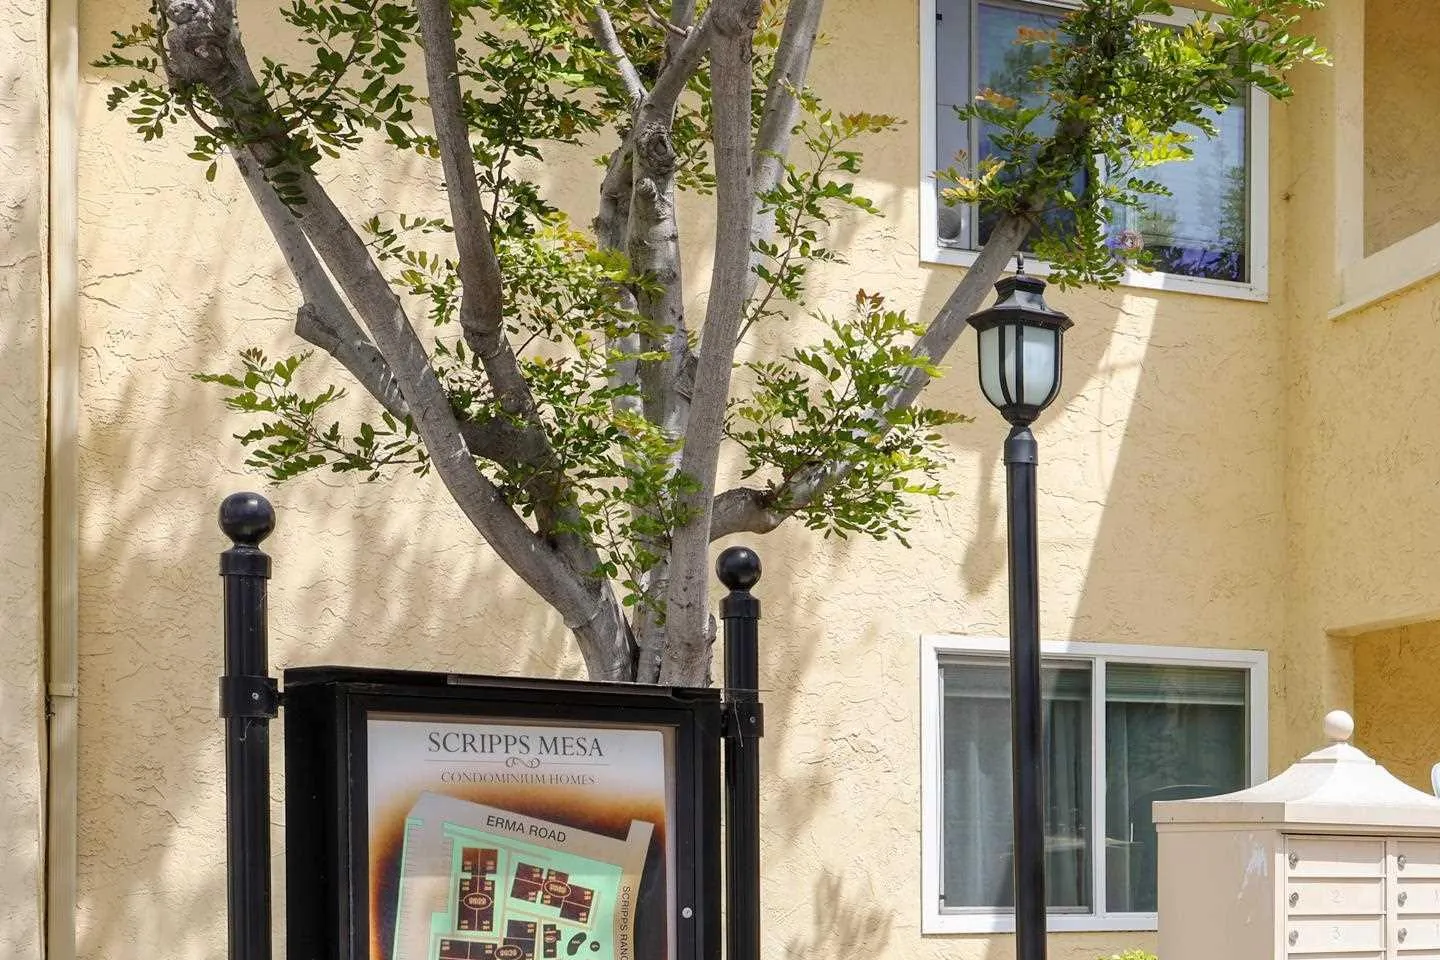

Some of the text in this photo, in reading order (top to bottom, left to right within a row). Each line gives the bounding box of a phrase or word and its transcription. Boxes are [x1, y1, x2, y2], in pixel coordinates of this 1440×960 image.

[427, 731, 604, 757] SCRIPPS MESA
[440, 770, 596, 785] CONDOMINIUM HOMES
[486, 814, 567, 844] ERMA ROAD
[620, 886, 631, 932] SCRIPPS
[1332, 926, 1342, 940] 3
